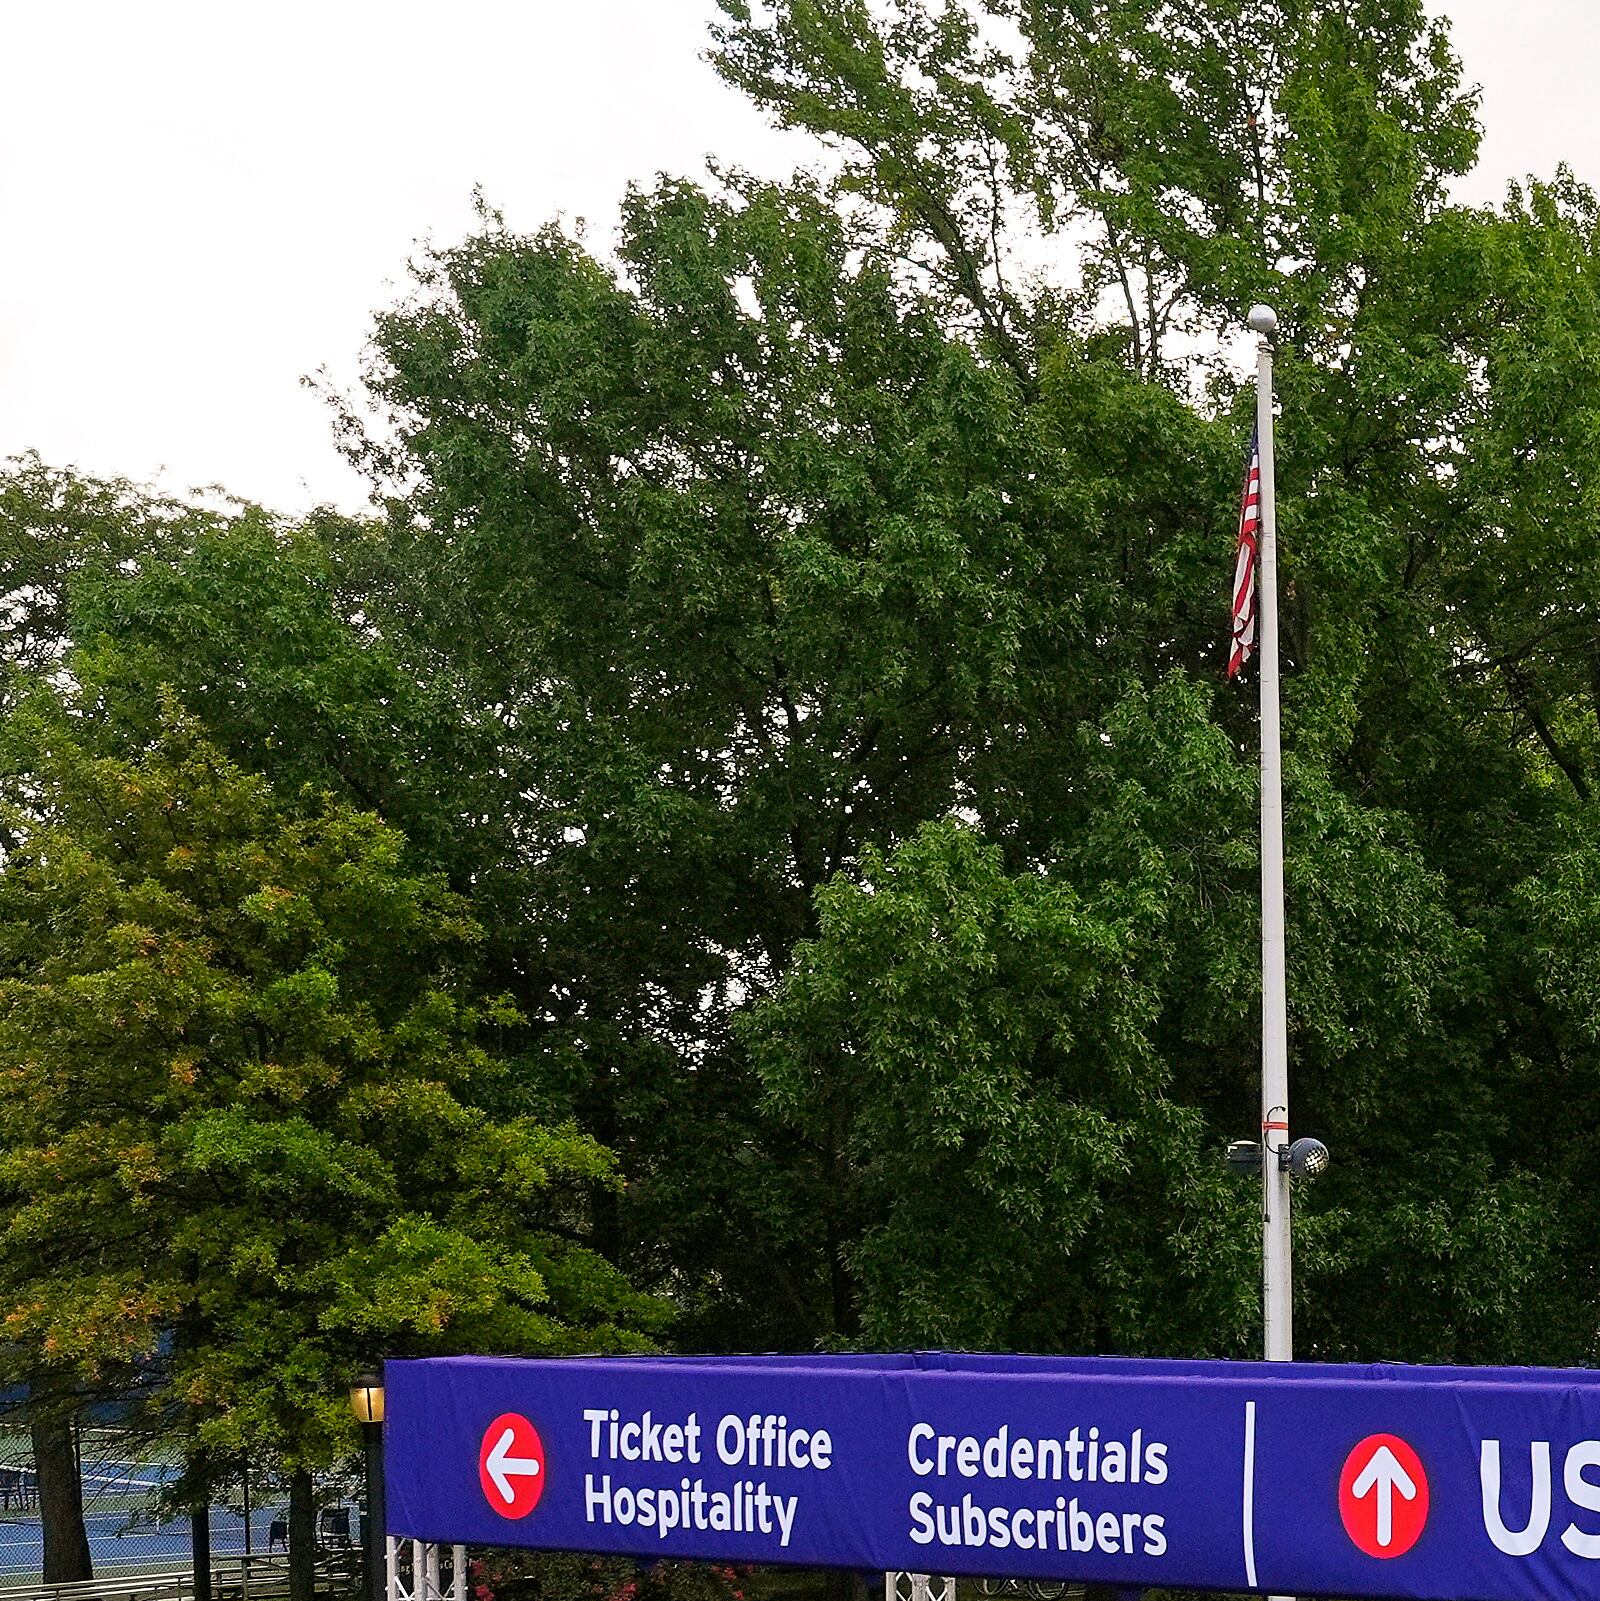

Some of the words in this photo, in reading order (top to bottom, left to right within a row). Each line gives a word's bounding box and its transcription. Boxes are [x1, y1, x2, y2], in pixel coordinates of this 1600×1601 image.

[584, 1409, 700, 1464] Ticket
[717, 1414, 832, 1470] Office
[909, 1422, 1168, 1485] Credentials
[585, 1474, 798, 1547] Hospitality
[910, 1491, 1167, 1556] Subscribers
